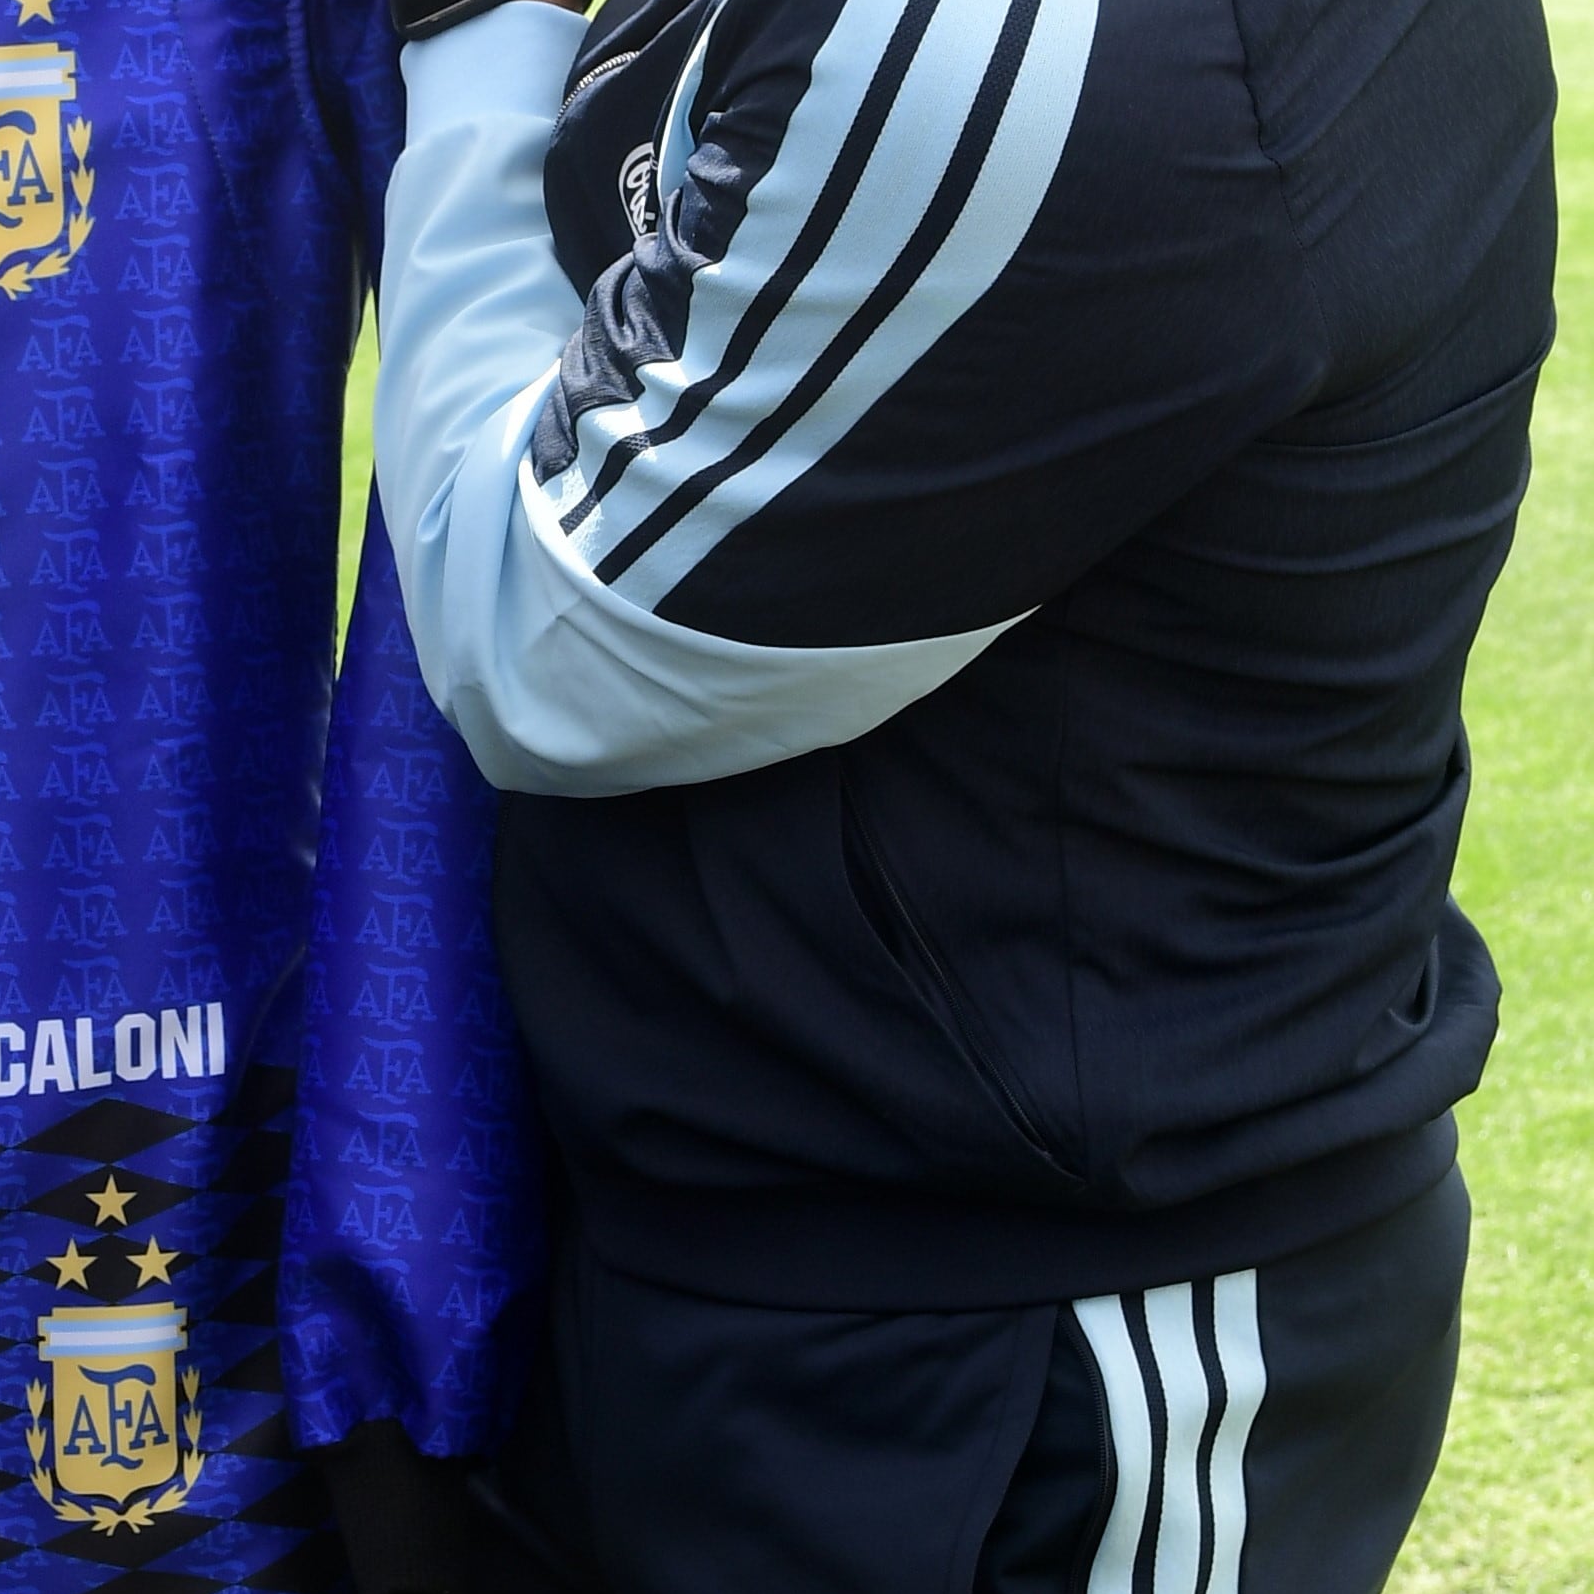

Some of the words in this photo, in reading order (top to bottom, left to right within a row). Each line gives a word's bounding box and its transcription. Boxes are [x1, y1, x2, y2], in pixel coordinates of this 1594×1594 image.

[21, 312, 96, 375] AFA
[114, 306, 196, 364] AFA
[25, 384, 100, 447] AFA
[127, 373, 205, 444] AFA
[29, 455, 104, 518] AFA
[129, 445, 207, 516] AFA
[32, 526, 107, 589] AFA
[130, 518, 205, 581] AFA
[33, 597, 108, 660] AFA
[136, 587, 214, 658] AFA
[38, 668, 113, 731] AFA
[138, 661, 213, 724] AFA
[32, 742, 114, 800] AFA
[141, 731, 216, 794] AFA
[36, 813, 118, 871] AFA
[145, 802, 220, 865] AFA
[364, 813, 443, 882] AFA
[40, 885, 122, 943] AFA
[149, 873, 224, 936] AFA
[355, 890, 432, 955] AFA
[350, 963, 427, 1028] AFA
[341, 1034, 427, 1098] AFA
[62, 1364, 169, 1470] AFA
